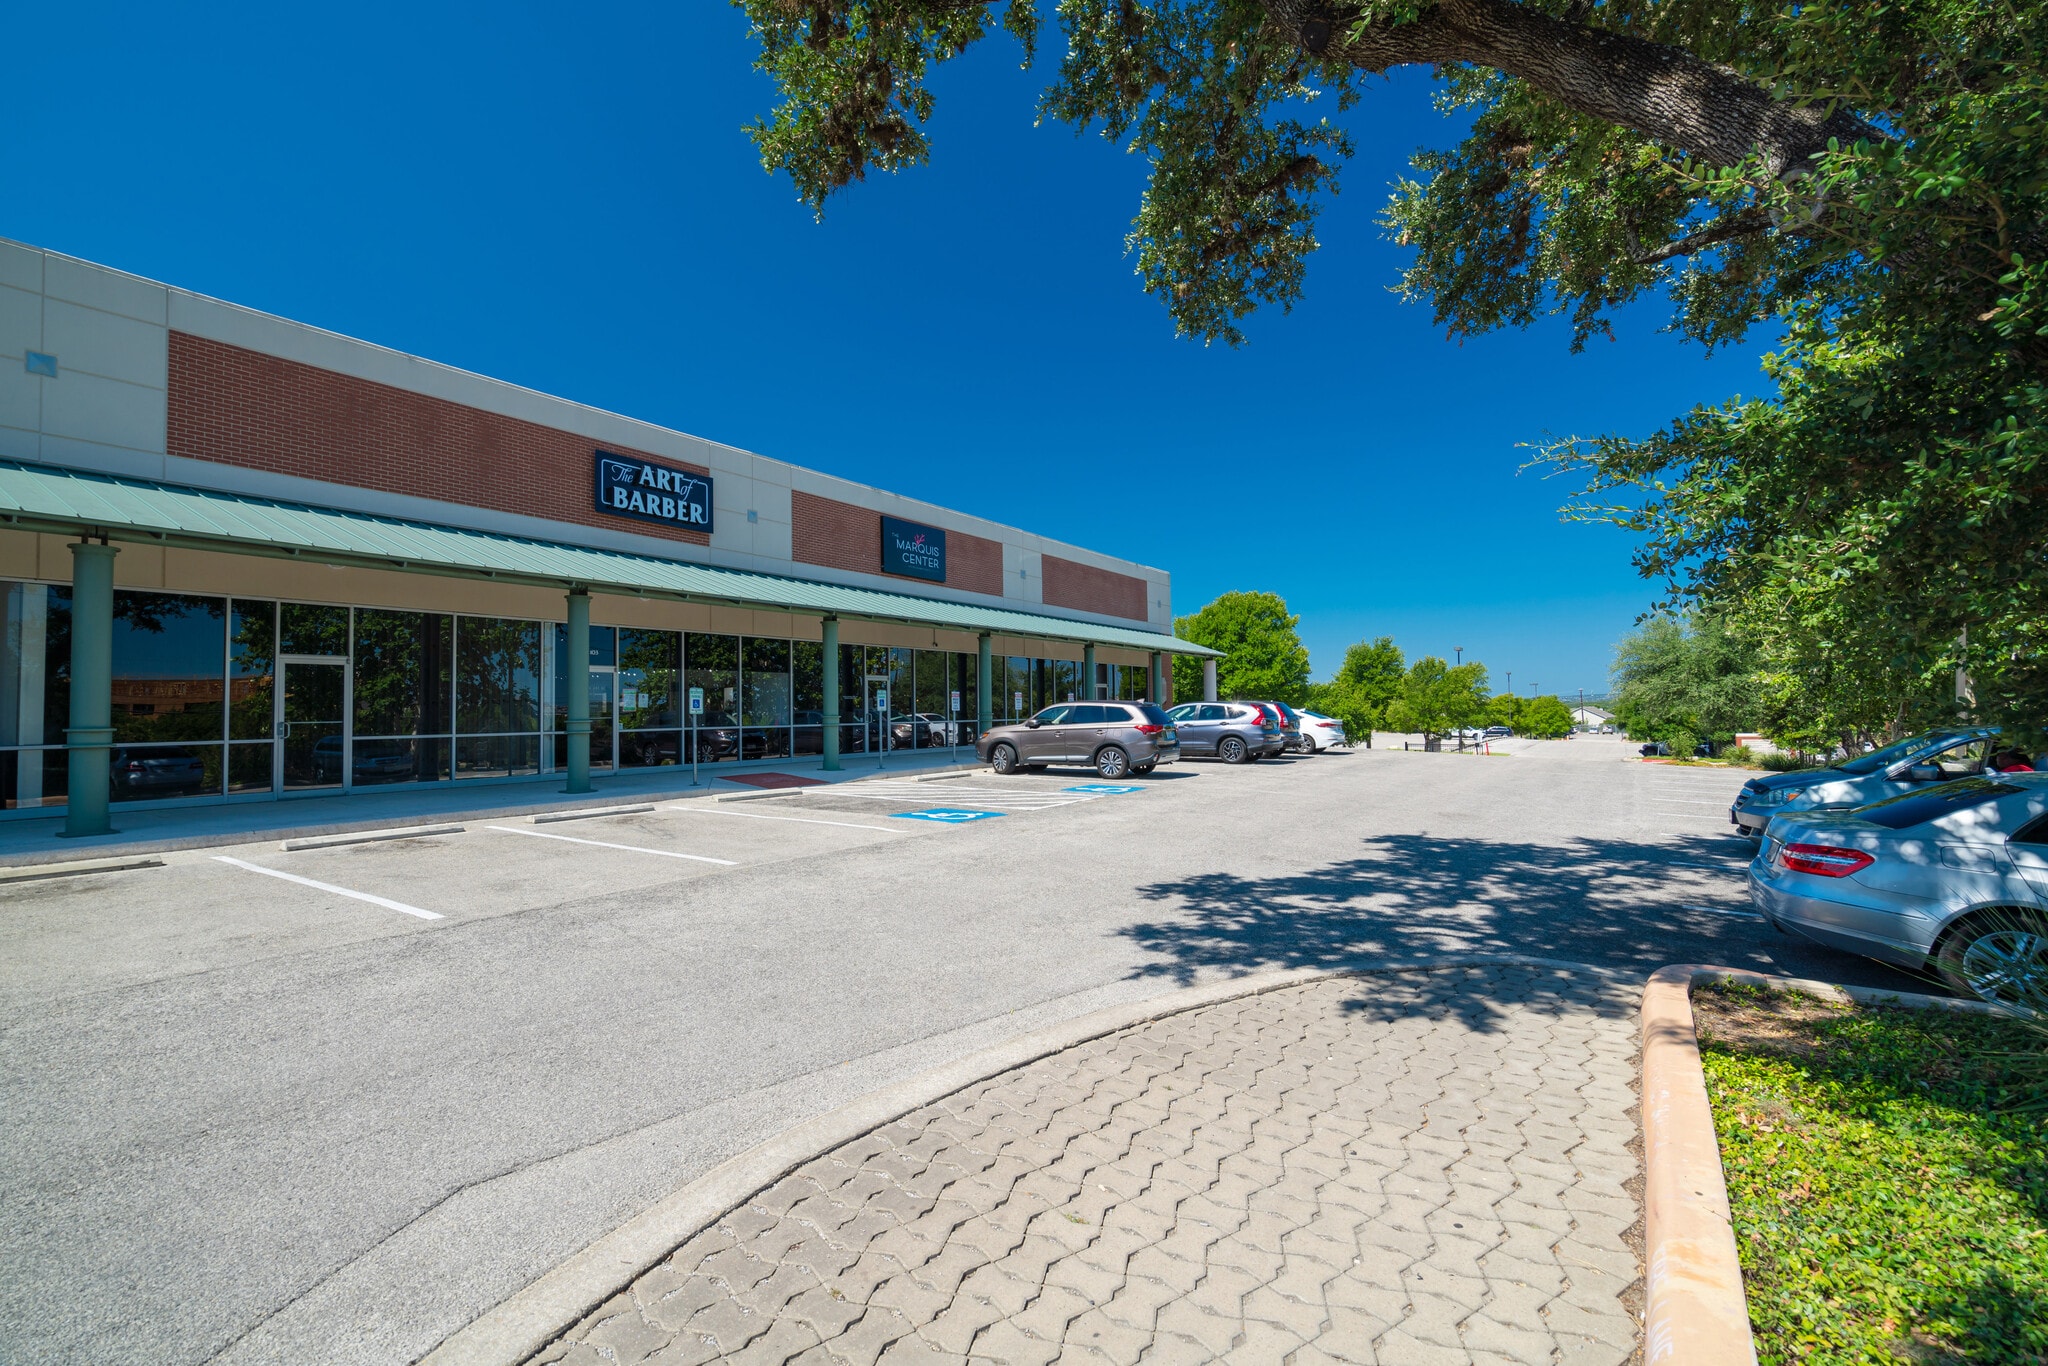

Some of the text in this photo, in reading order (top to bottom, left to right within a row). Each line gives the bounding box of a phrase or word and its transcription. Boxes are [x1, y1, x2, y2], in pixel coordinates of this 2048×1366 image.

[612, 464, 698, 501] The ART of
[613, 486, 703, 523] BARBER
[896, 539, 940, 557] MARQUIS
[902, 552, 939, 568] CENTER
